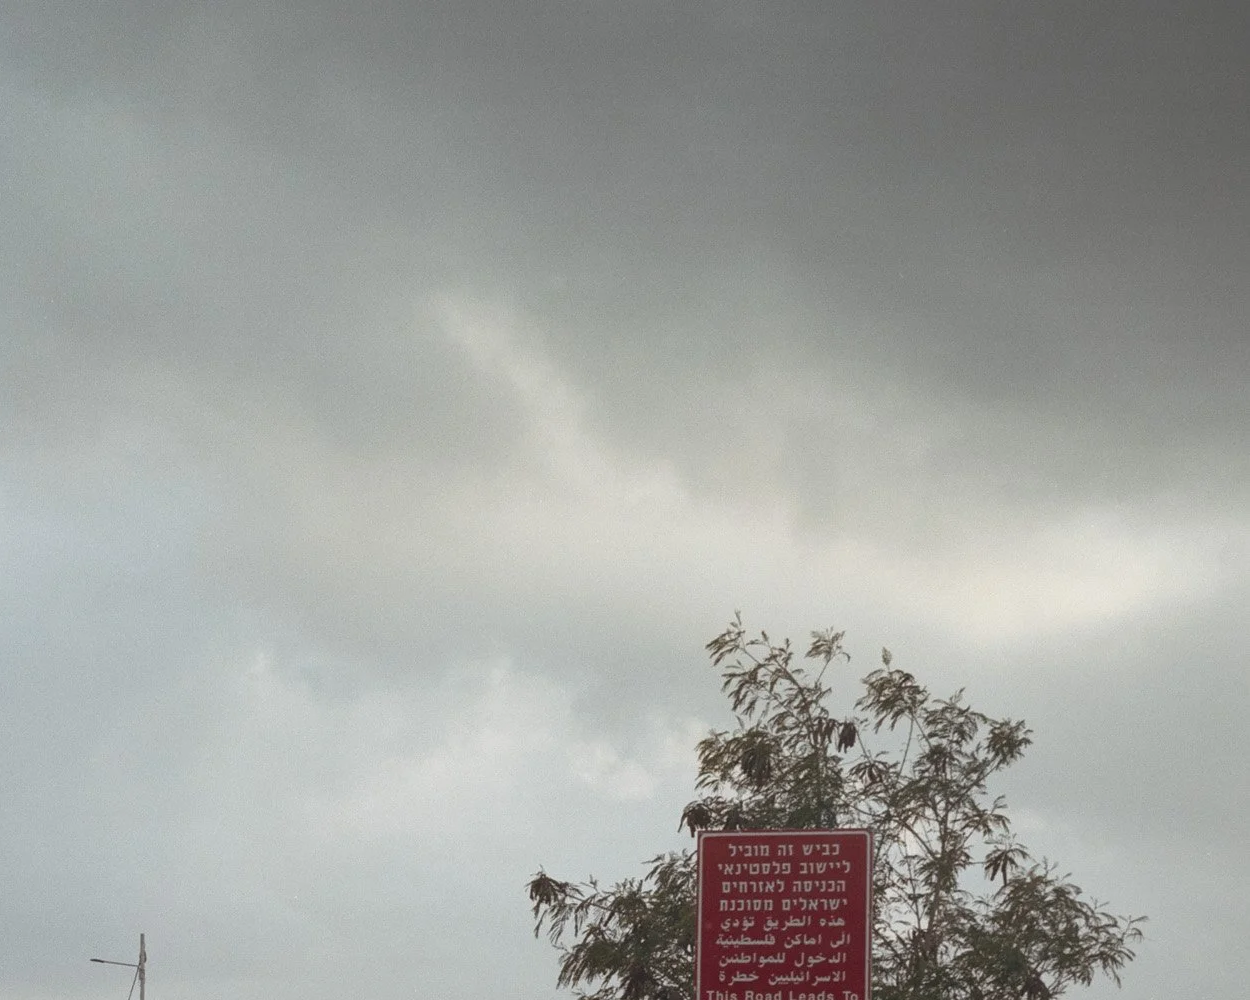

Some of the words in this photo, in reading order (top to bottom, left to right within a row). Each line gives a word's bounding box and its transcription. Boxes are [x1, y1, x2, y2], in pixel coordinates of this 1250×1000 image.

[728, 843, 770, 857] מוביל
[777, 844, 794, 857] זה
[802, 843, 840, 856] כביש
[717, 861, 791, 875] פלסטינאי
[799, 860, 851, 874] ליישוב
[722, 879, 785, 893] לאזרחים
[792, 880, 846, 893] הכניסה
[781, 897, 848, 911] ישראלים
[720, 915, 755, 932] تؤدي
[763, 915, 811, 930] الطريق
[819, 914, 845, 926] هذه
[715, 932, 776, 949] فلسطينية
[794, 951, 847, 967] الدخول
[718, 970, 759, 986] خطرة
